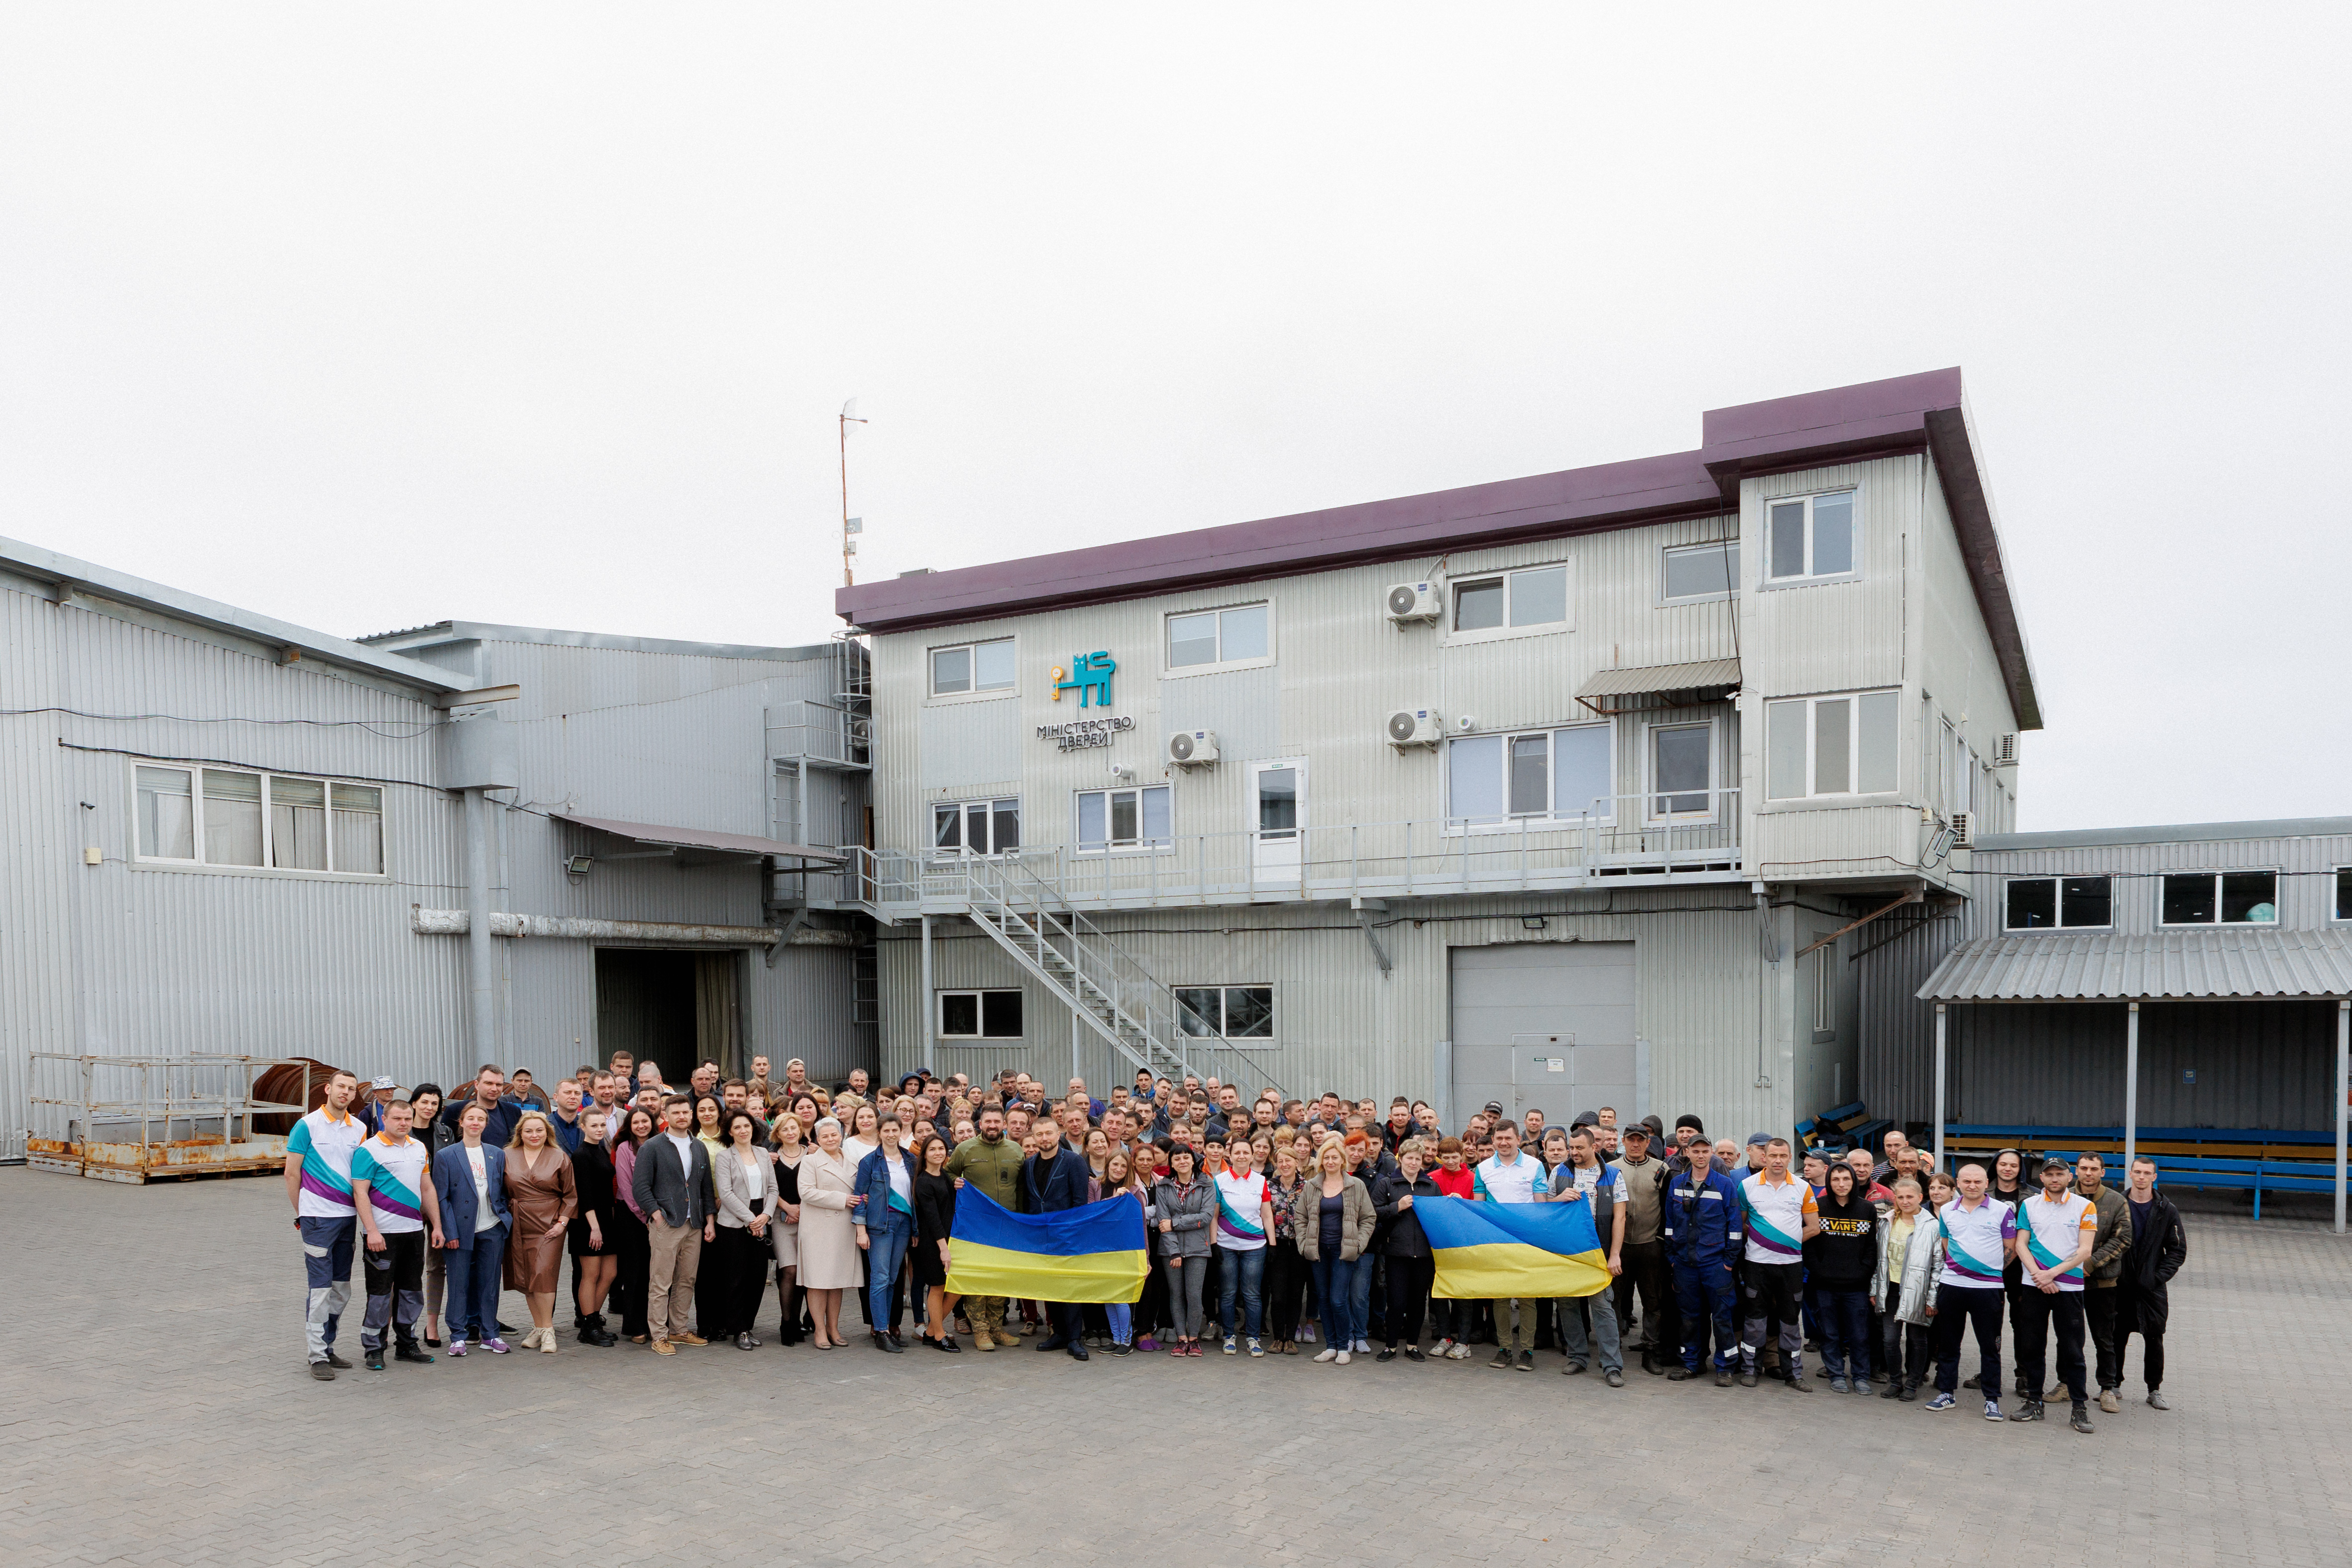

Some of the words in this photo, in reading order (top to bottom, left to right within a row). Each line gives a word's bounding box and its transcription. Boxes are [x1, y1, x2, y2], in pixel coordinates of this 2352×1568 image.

[1037, 716, 1131, 738] МІНІСТЕРСТВО
[1058, 731, 1108, 751] ДВЕРЕЙ
[1829, 1221, 1857, 1231] VANS
